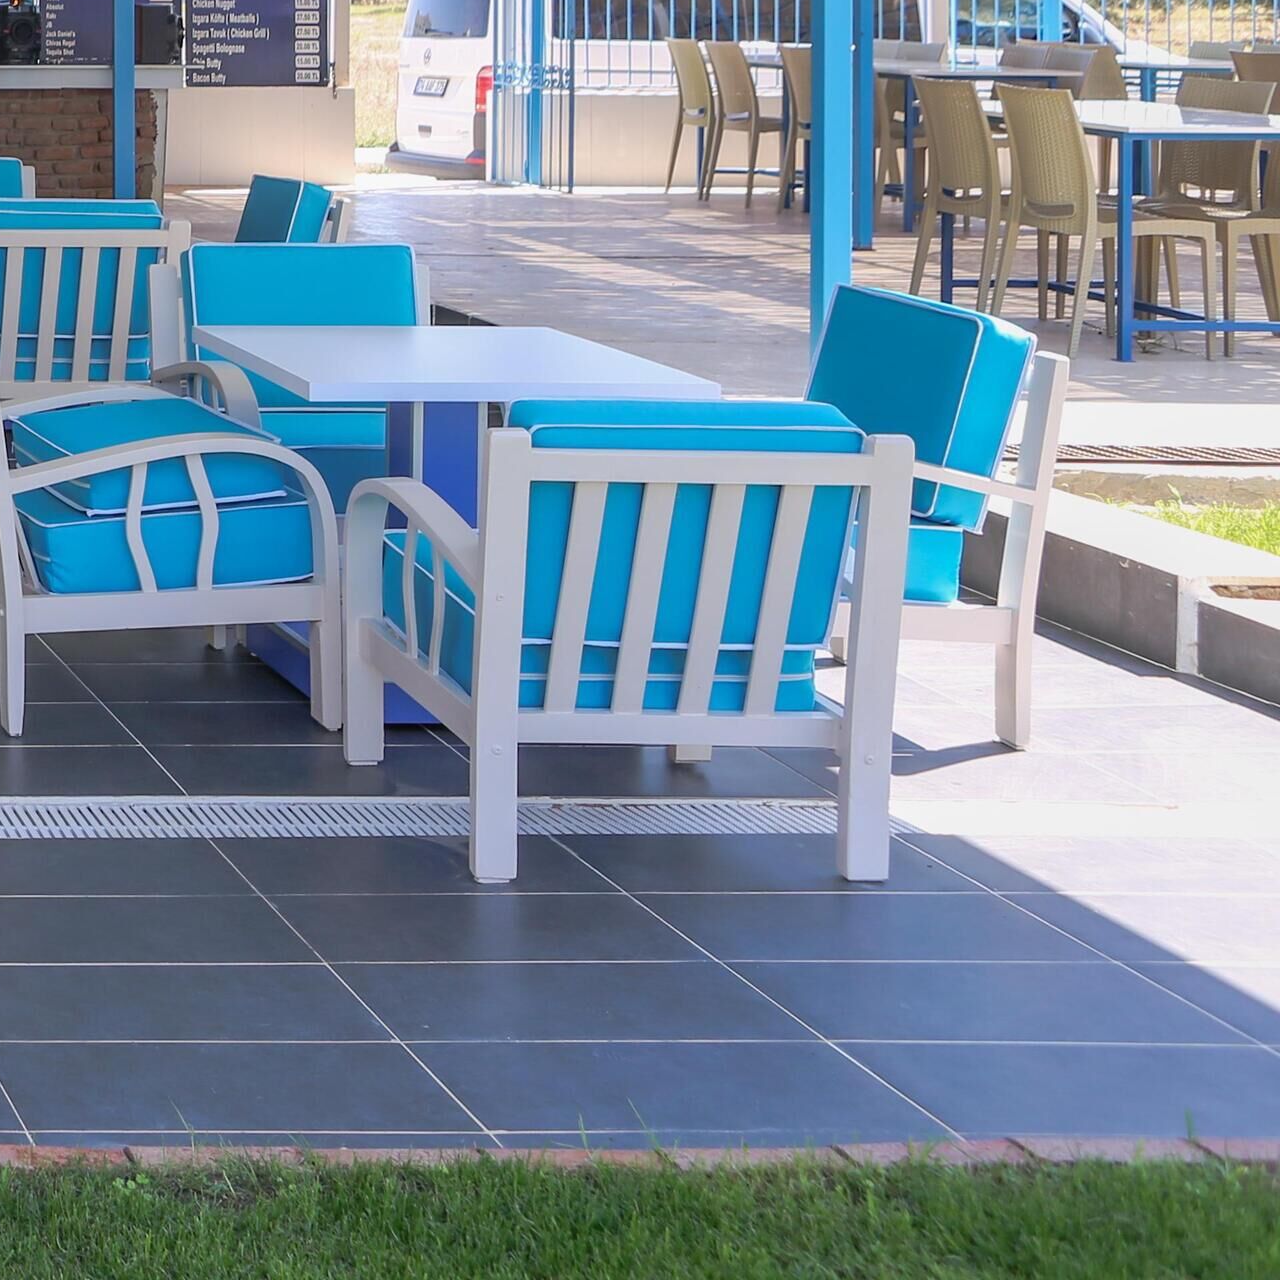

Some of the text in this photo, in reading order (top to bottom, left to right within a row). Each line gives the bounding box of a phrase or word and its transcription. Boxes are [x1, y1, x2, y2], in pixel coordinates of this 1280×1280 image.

[312, 0, 318, 7] TL
[229, 14, 255, 23] Meatballs
[312, 13, 318, 21] TL
[46, 30, 56, 38] Jack
[210, 28, 227, 38] Tavuk
[231, 28, 253, 38] Chicken
[254, 28, 266, 38] Grill
[312, 28, 318, 36] TL
[46, 39, 61, 47] Chivas
[312, 42, 318, 51] TL
[206, 58, 221, 70] Butty
[312, 57, 318, 66] TL
[193, 73, 226, 85] Bacon Butty
[312, 72, 318, 80] TL
